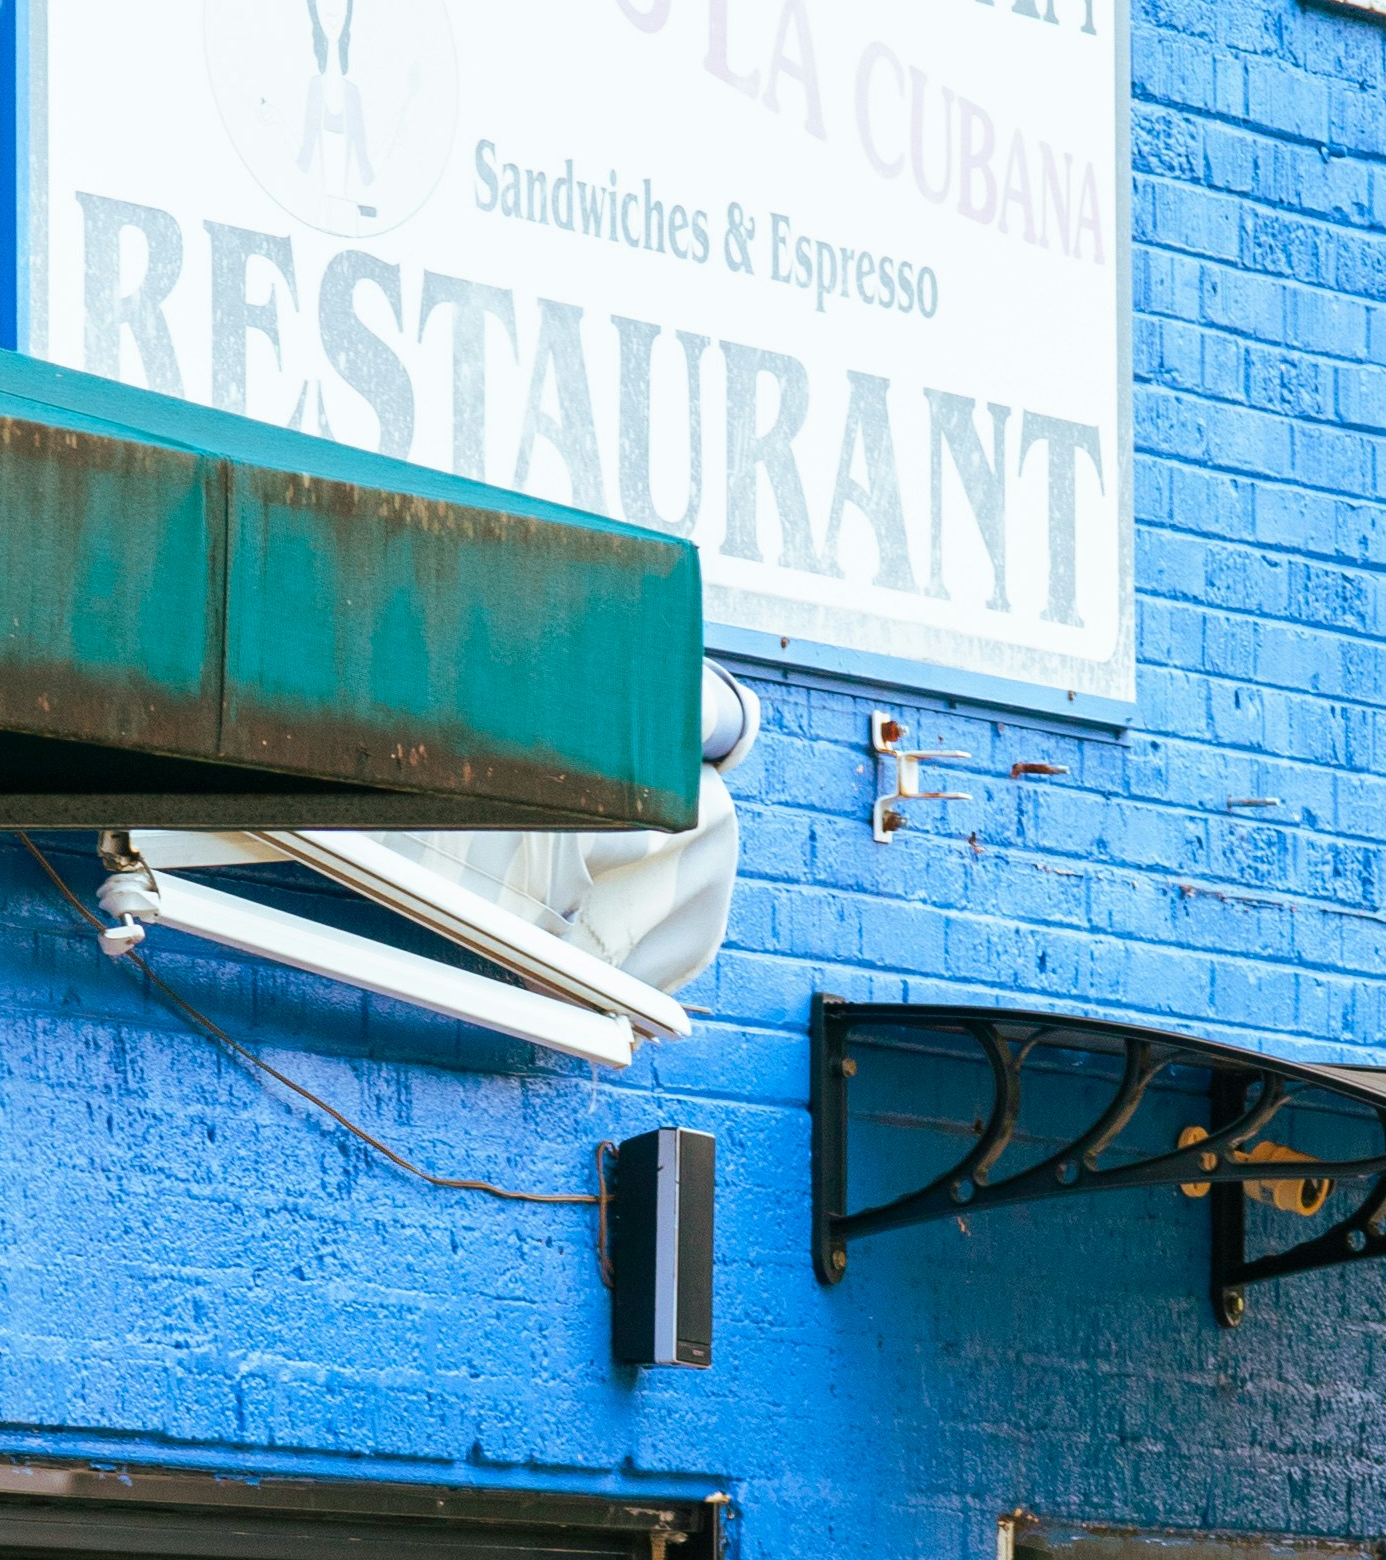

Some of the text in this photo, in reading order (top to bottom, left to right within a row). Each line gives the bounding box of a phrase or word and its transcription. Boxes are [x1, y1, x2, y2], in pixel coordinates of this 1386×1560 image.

[472, 135, 940, 322] Sandwiches & Espresso
[852, 40, 1107, 267] CUBANA
[73, 190, 1107, 631] RESTAURANT
